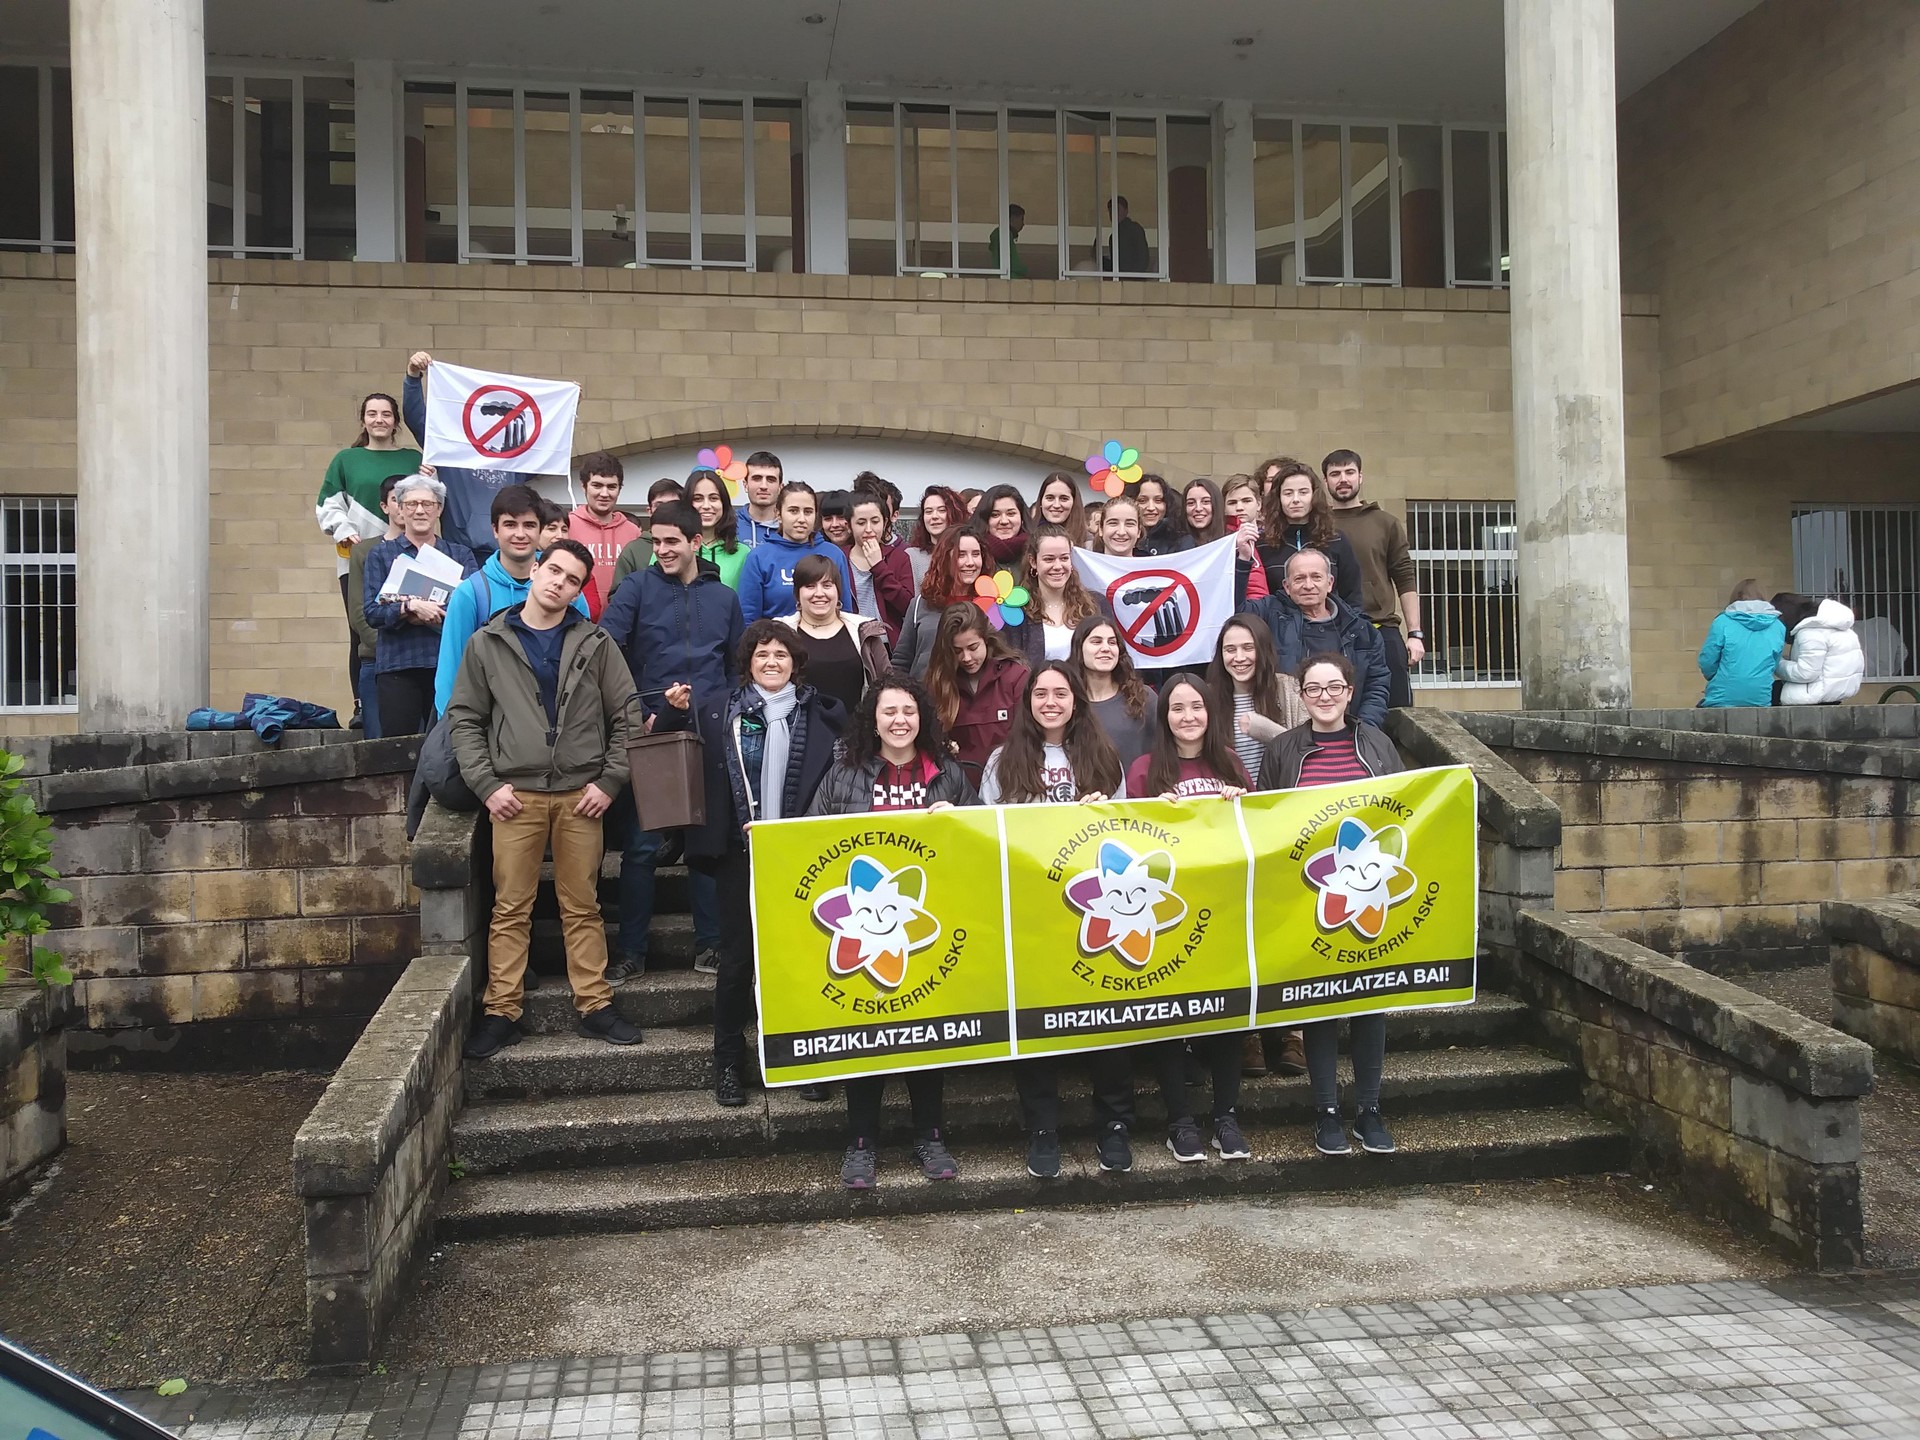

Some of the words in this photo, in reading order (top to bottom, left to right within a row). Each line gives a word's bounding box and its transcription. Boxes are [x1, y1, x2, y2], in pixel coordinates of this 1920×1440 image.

[586, 543, 621, 559] KELA
[1047, 818, 1181, 883] ERRAUSKETARIK?
[1289, 794, 1414, 862] ERRAUSKETARIK?
[794, 831, 937, 901] ERRAUSKETARIK?
[1071, 960, 1096, 986] EZ,
[1100, 953, 1186, 992] ESKERRIK
[1183, 908, 1212, 957] ASKO
[1310, 936, 1332, 960] EZ,
[1336, 926, 1414, 964] ESKERRIK
[1412, 881, 1440, 929] ASKO
[821, 982, 847, 1010] EZ,
[852, 974, 941, 1015] ESKERRIK
[938, 928, 967, 979] ASKO
[1282, 970, 1409, 1003] BIRZIKLATZEA
[1413, 966, 1450, 984] BAI!
[793, 1024, 938, 1057] BIRZIKLATZEA
[943, 1019, 982, 1041] BAI!
[1044, 1001, 1183, 1030] BIRZIKLATZEA
[1188, 996, 1225, 1016] BAI!
